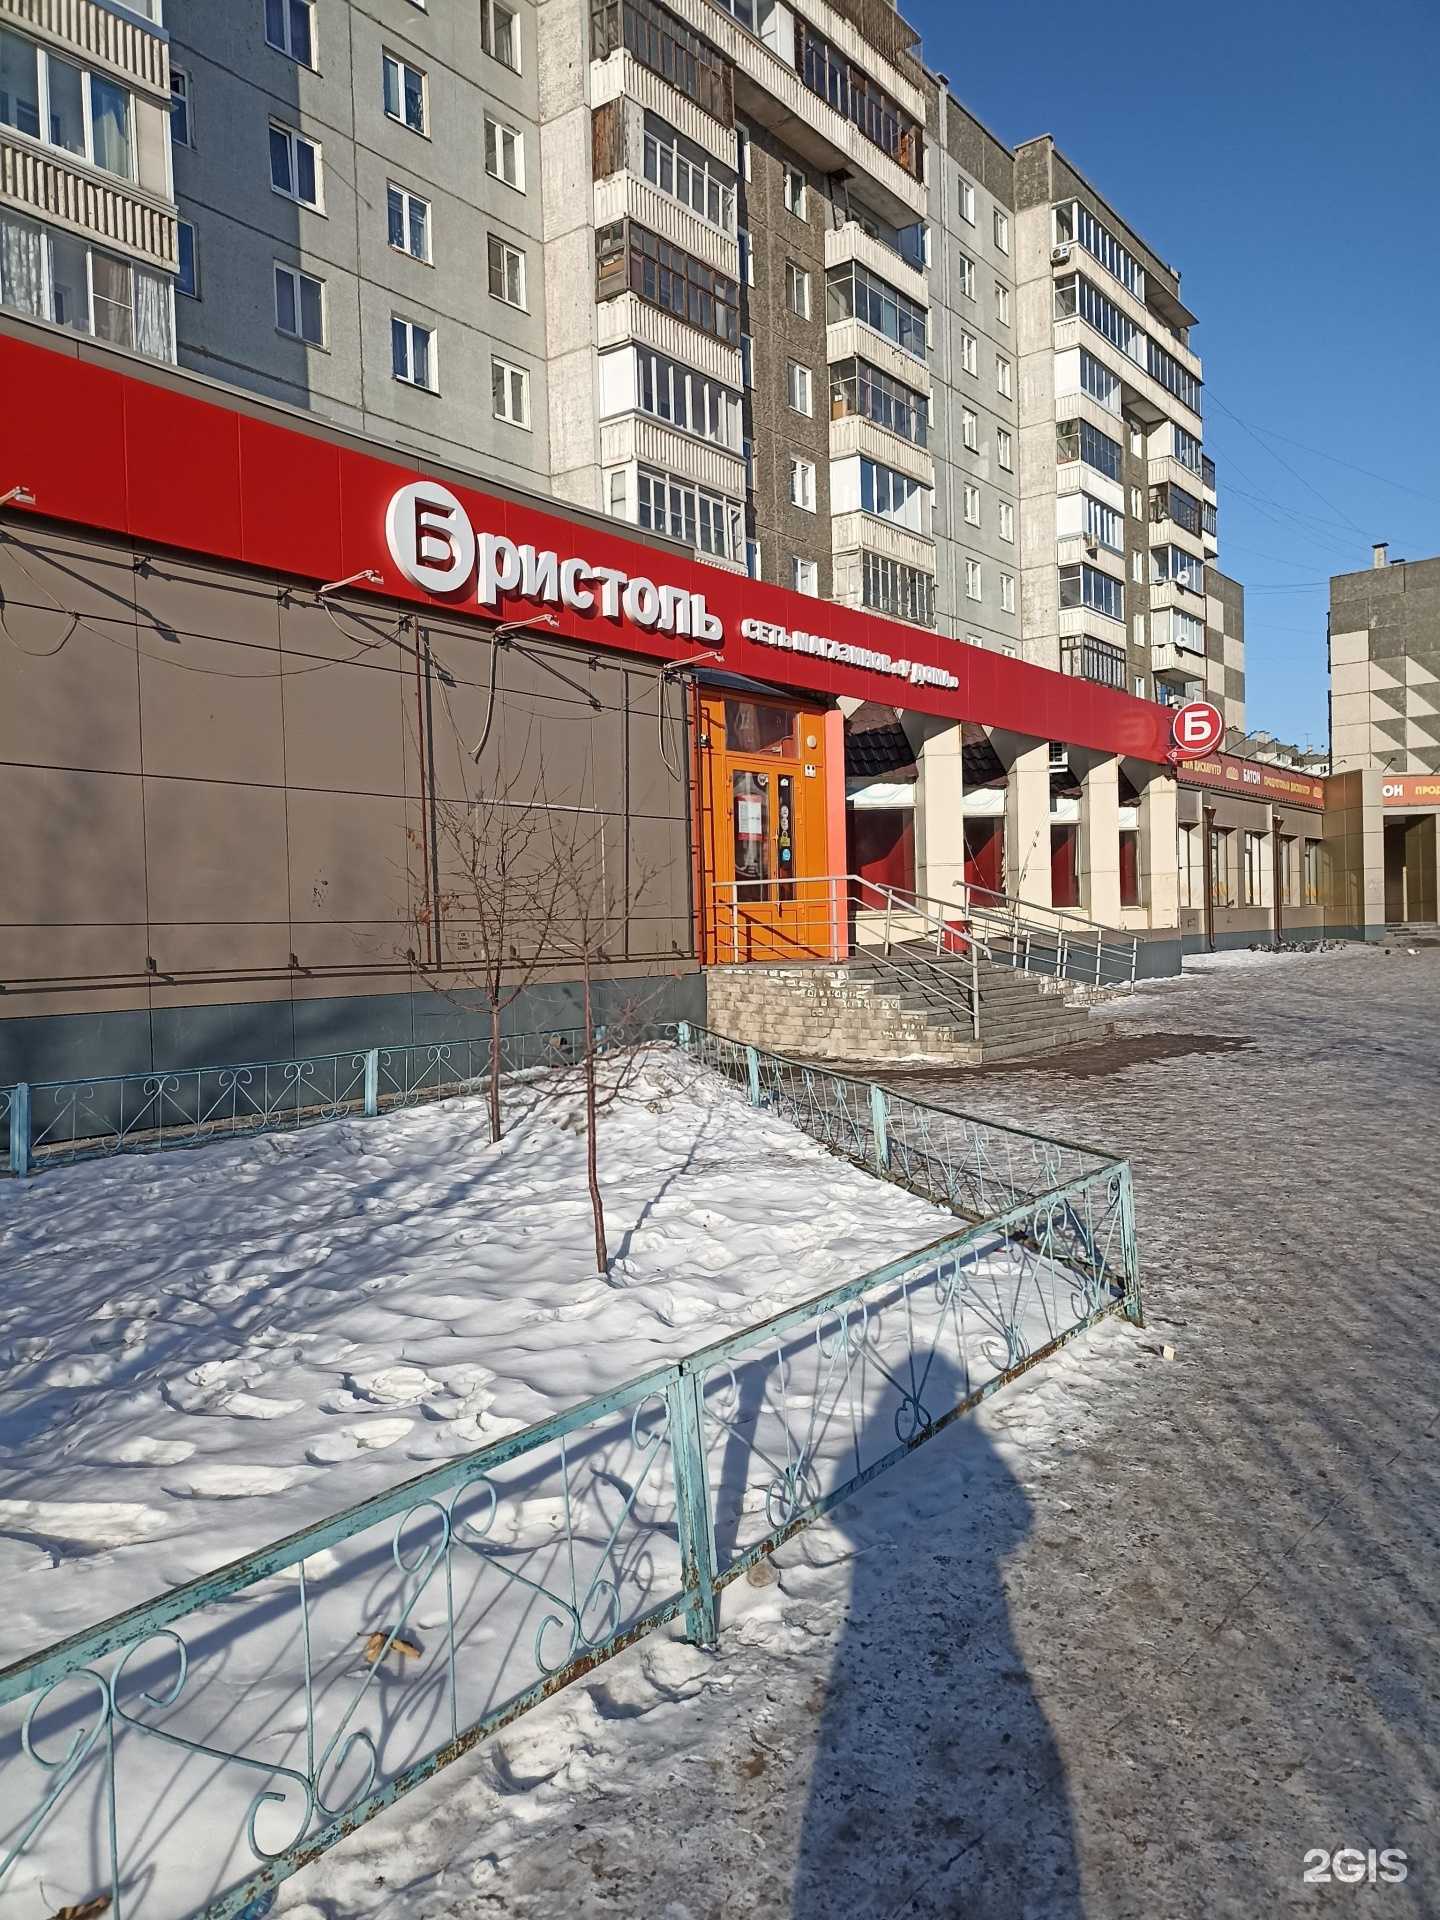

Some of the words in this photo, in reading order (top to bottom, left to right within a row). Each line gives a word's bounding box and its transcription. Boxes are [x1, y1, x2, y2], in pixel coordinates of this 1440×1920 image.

[385, 480, 724, 641] Бристоль
[741, 618, 793, 648] СЕТЬ
[792, 630, 892, 673] МАГАЗИНОВ
[1184, 710, 1212, 742] Б
[1243, 768, 1261, 785] БАТОН
